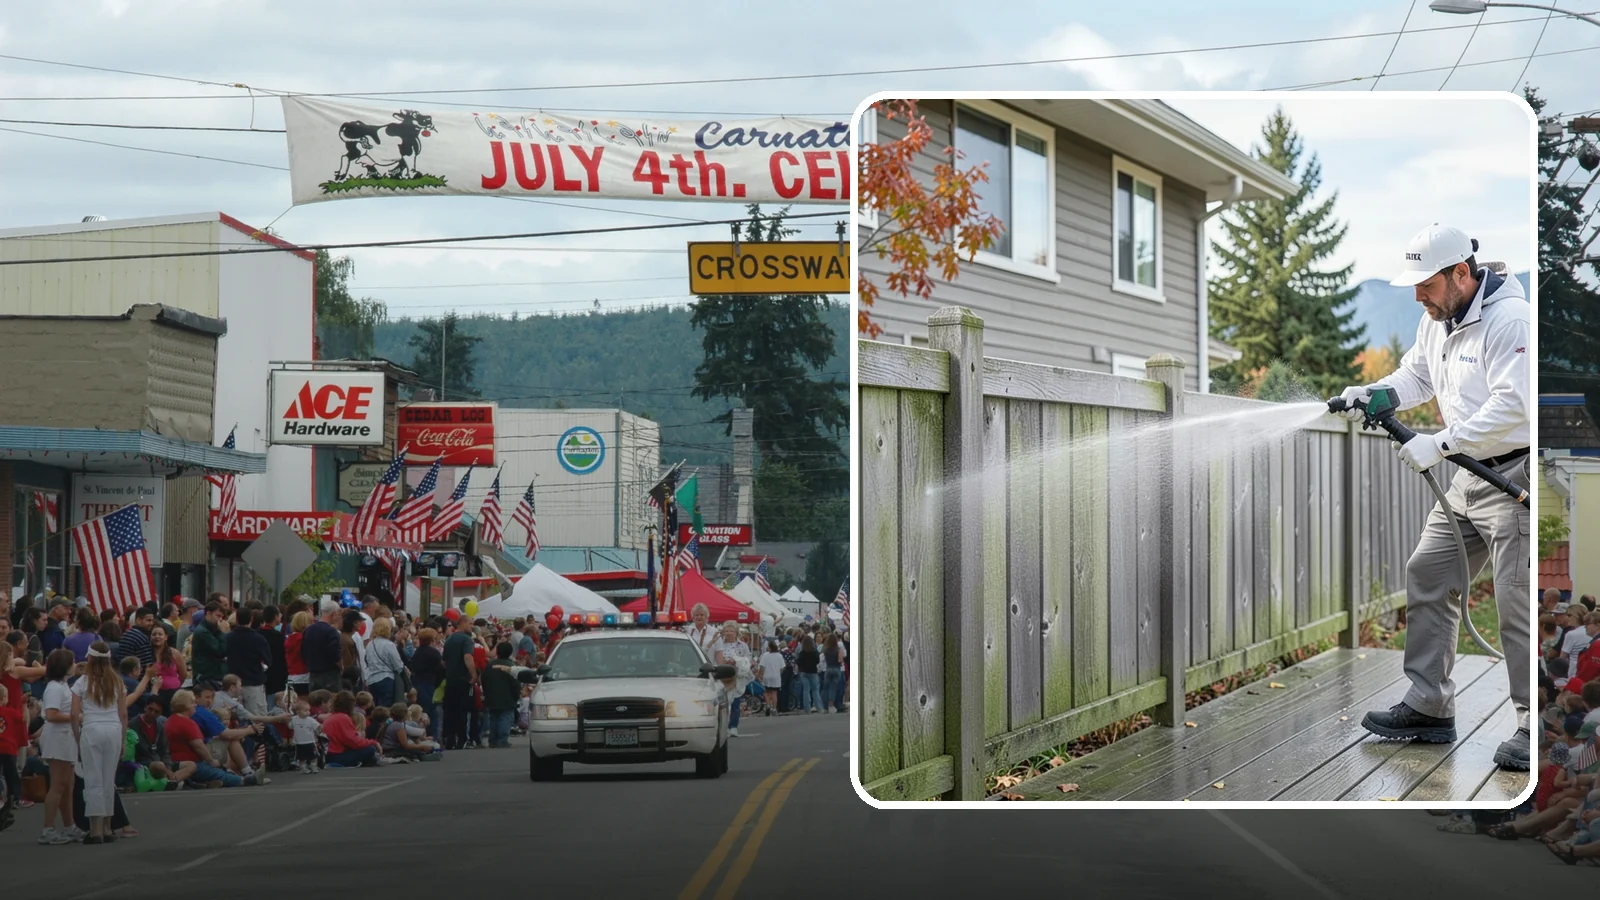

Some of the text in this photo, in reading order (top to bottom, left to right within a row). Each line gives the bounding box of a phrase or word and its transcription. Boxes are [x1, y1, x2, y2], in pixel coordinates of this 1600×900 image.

[481, 141, 604, 193] JULY
[632, 150, 747, 198] 4th.
[697, 254, 850, 280] CROSSWA
[283, 380, 373, 420] ACE
[405, 409, 452, 422] CEDAR
[283, 421, 371, 436] Hardware
[416, 428, 477, 447] Coca-Cola
[353, 467, 386, 480] Simpl
[83, 485, 155, 495] St. Vincent de Paul
[699, 535, 730, 543] GLASS
